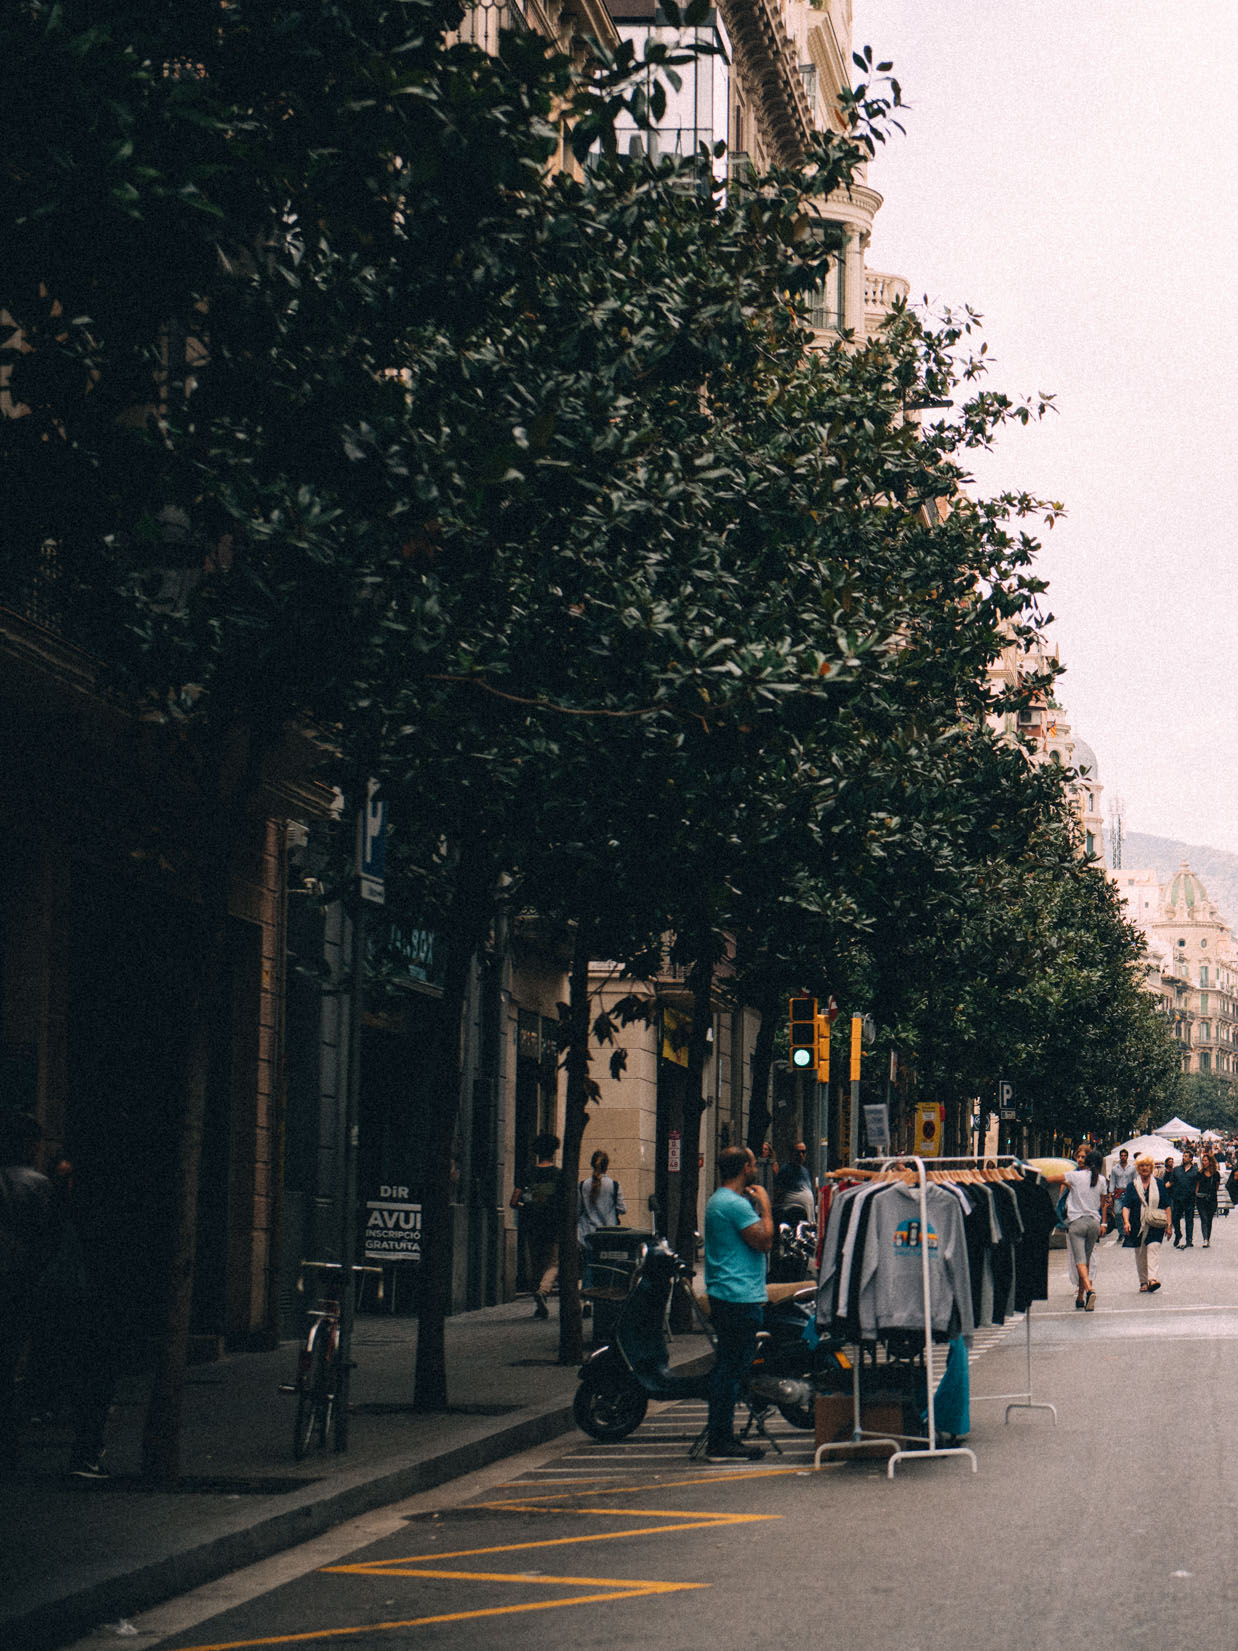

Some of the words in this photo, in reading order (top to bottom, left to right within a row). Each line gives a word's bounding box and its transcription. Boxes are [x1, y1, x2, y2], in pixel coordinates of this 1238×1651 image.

[1003, 1084, 1013, 1106] P
[366, 1210, 422, 1230] AVUI
[365, 1229, 421, 1240] INSCRIPCIÓ
